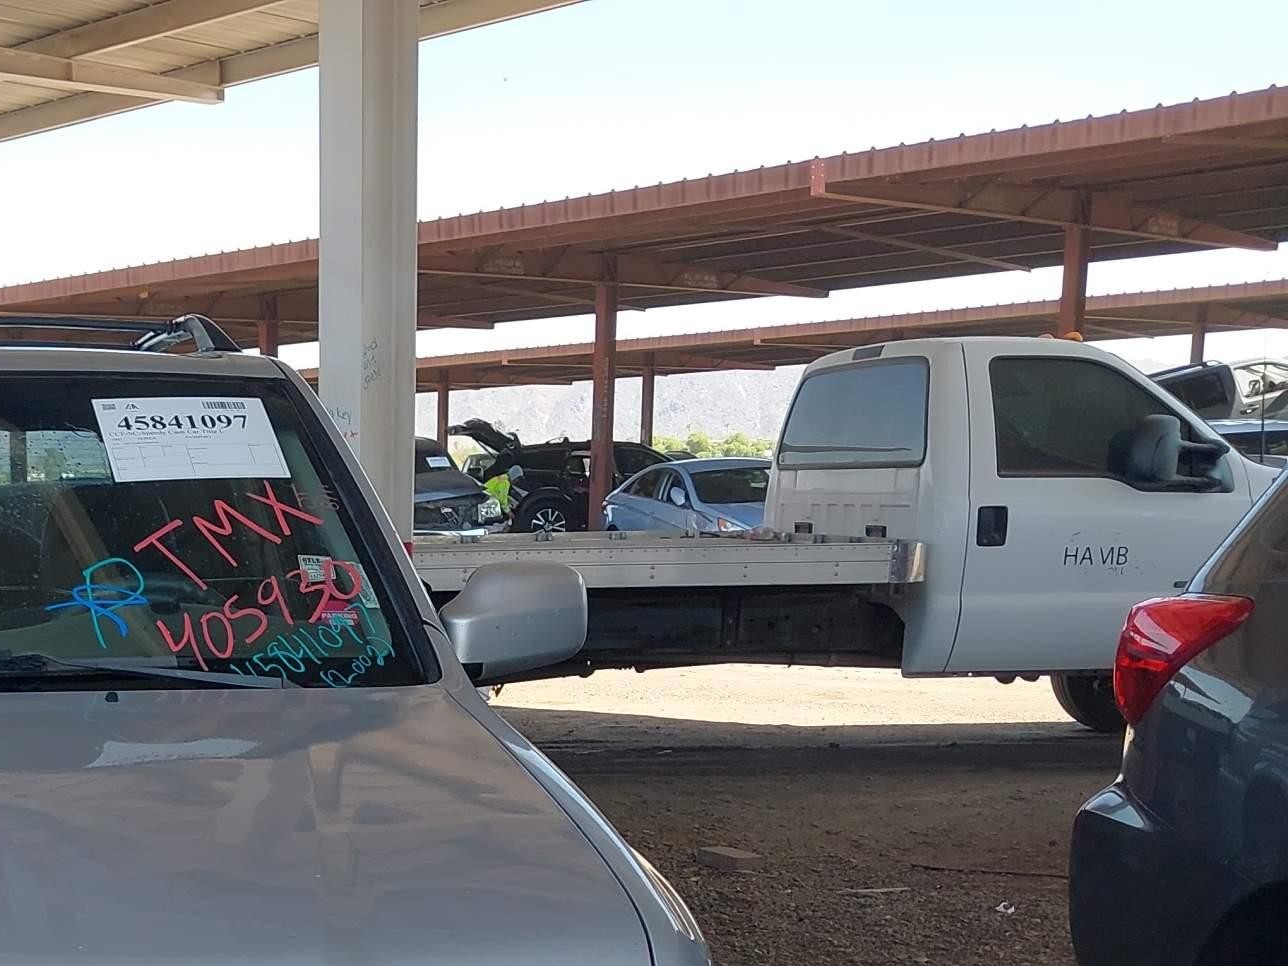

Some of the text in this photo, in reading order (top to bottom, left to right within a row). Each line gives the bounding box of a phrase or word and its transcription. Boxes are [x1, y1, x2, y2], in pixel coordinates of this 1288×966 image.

[117, 414, 249, 432] 45841097
[133, 480, 324, 591] TMX
[157, 560, 362, 672] 405930
